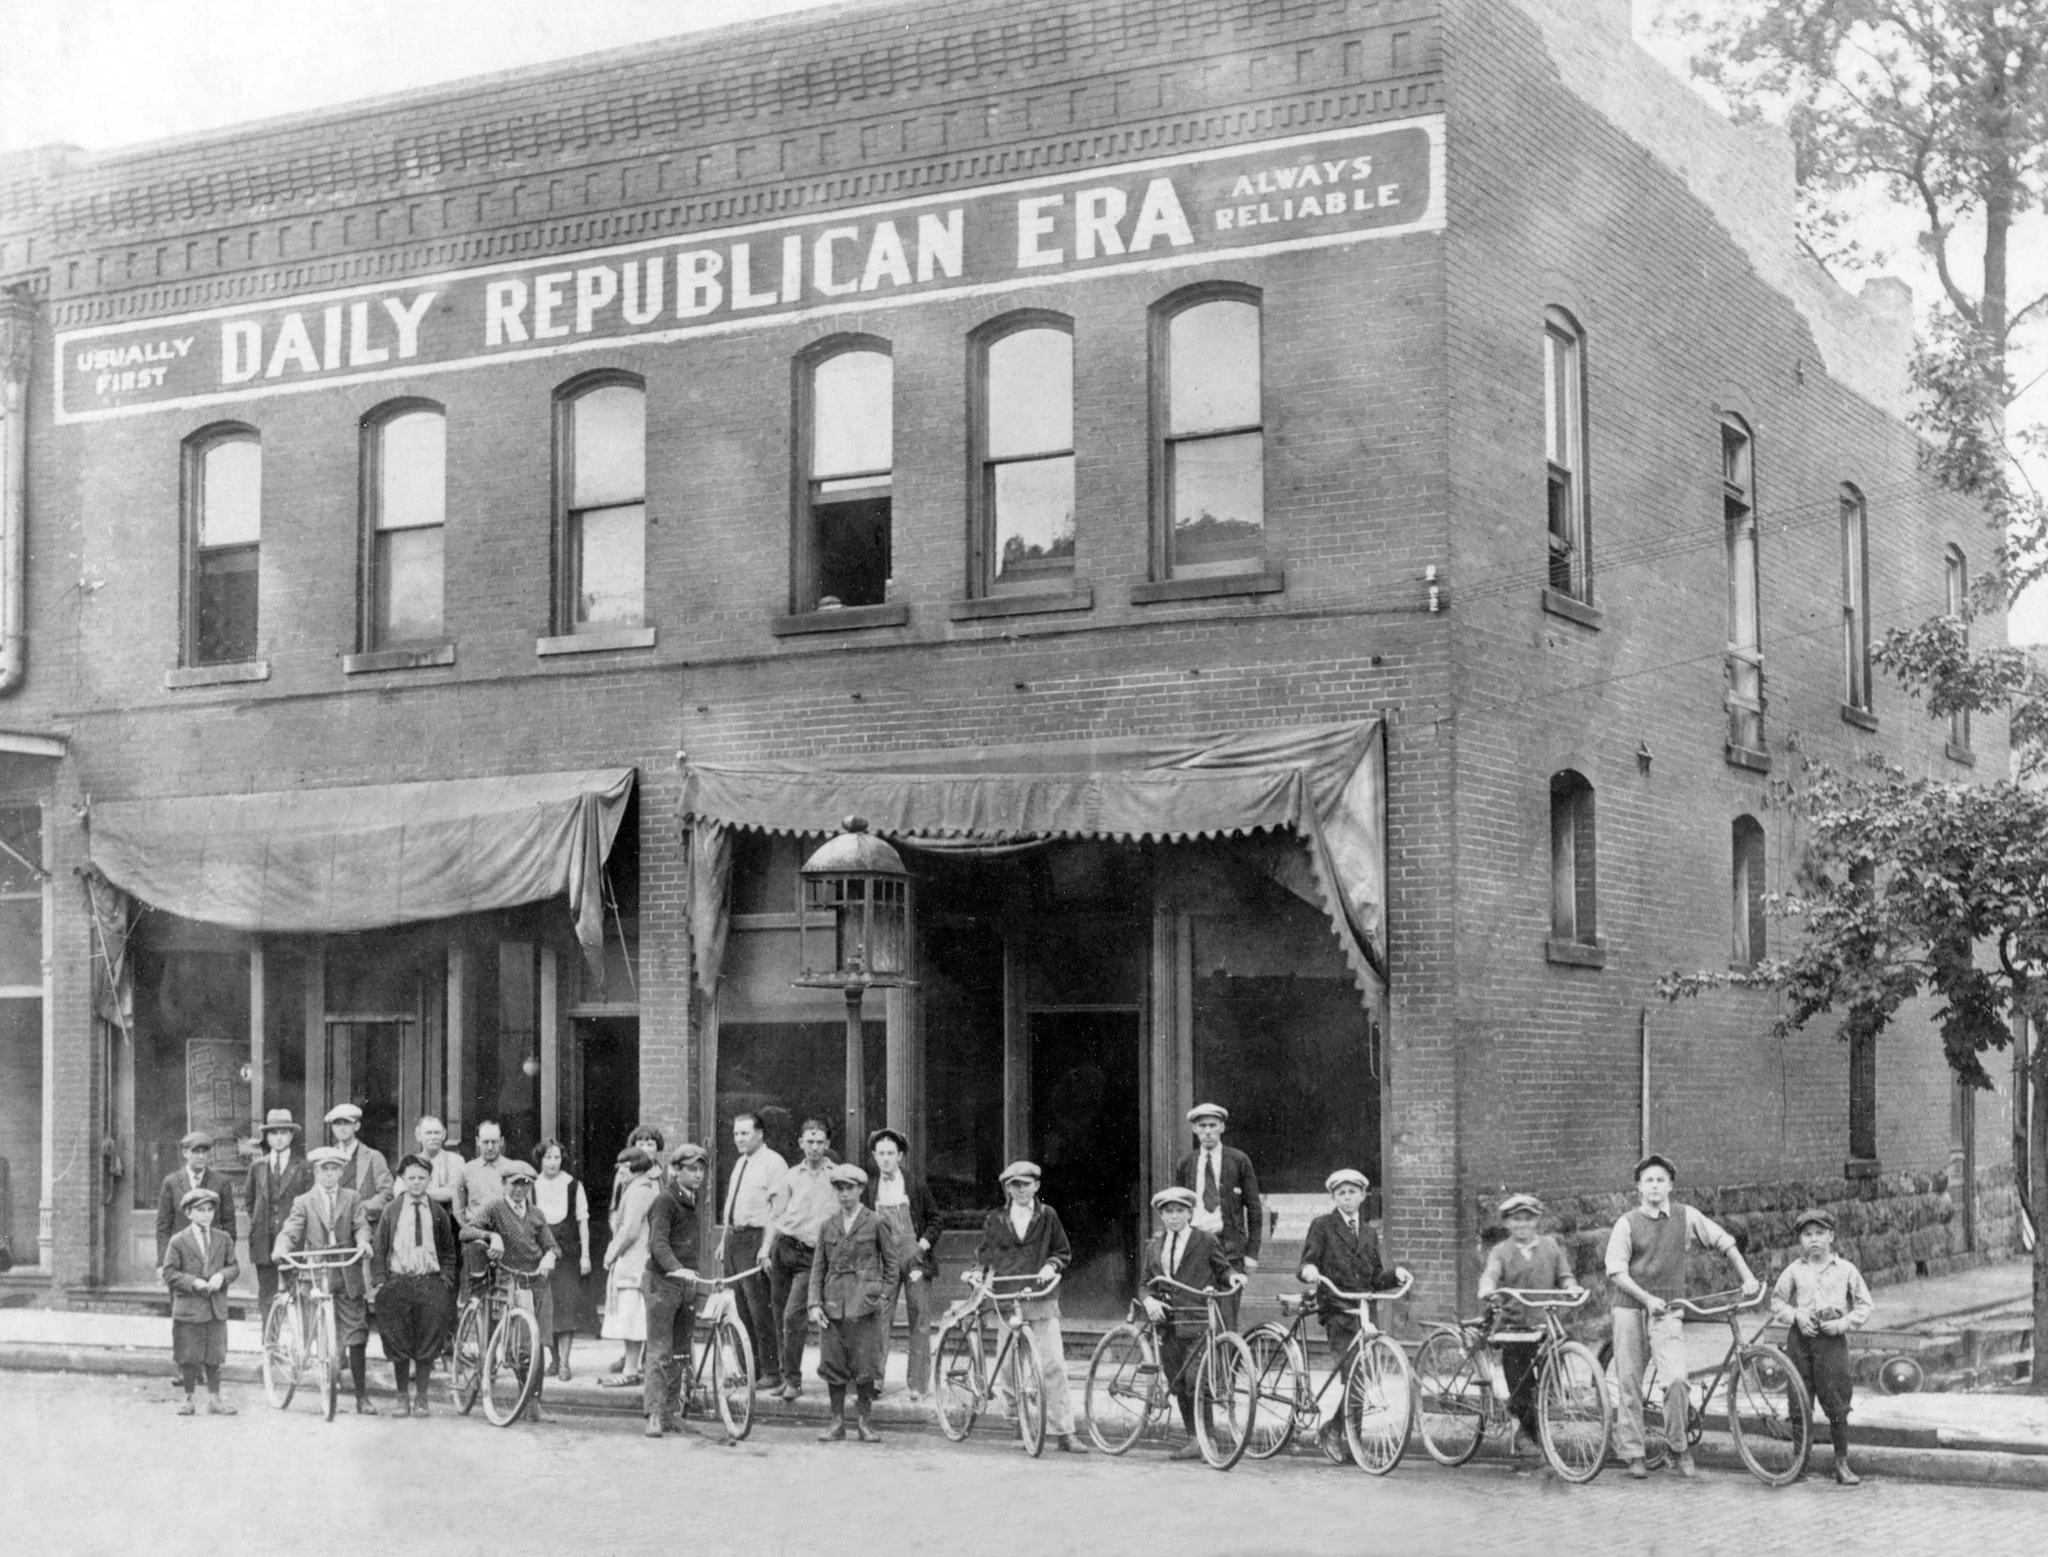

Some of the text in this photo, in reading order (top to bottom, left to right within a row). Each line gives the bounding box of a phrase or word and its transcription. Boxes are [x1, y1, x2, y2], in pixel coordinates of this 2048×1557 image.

[1229, 155, 1373, 198] ALWAYS
[1215, 183, 1400, 230] RELIABLE
[220, 177, 1195, 384] DAILY REPUBLICAN ERA
[77, 336, 195, 371] USUALLY
[95, 367, 168, 395] FIRST
